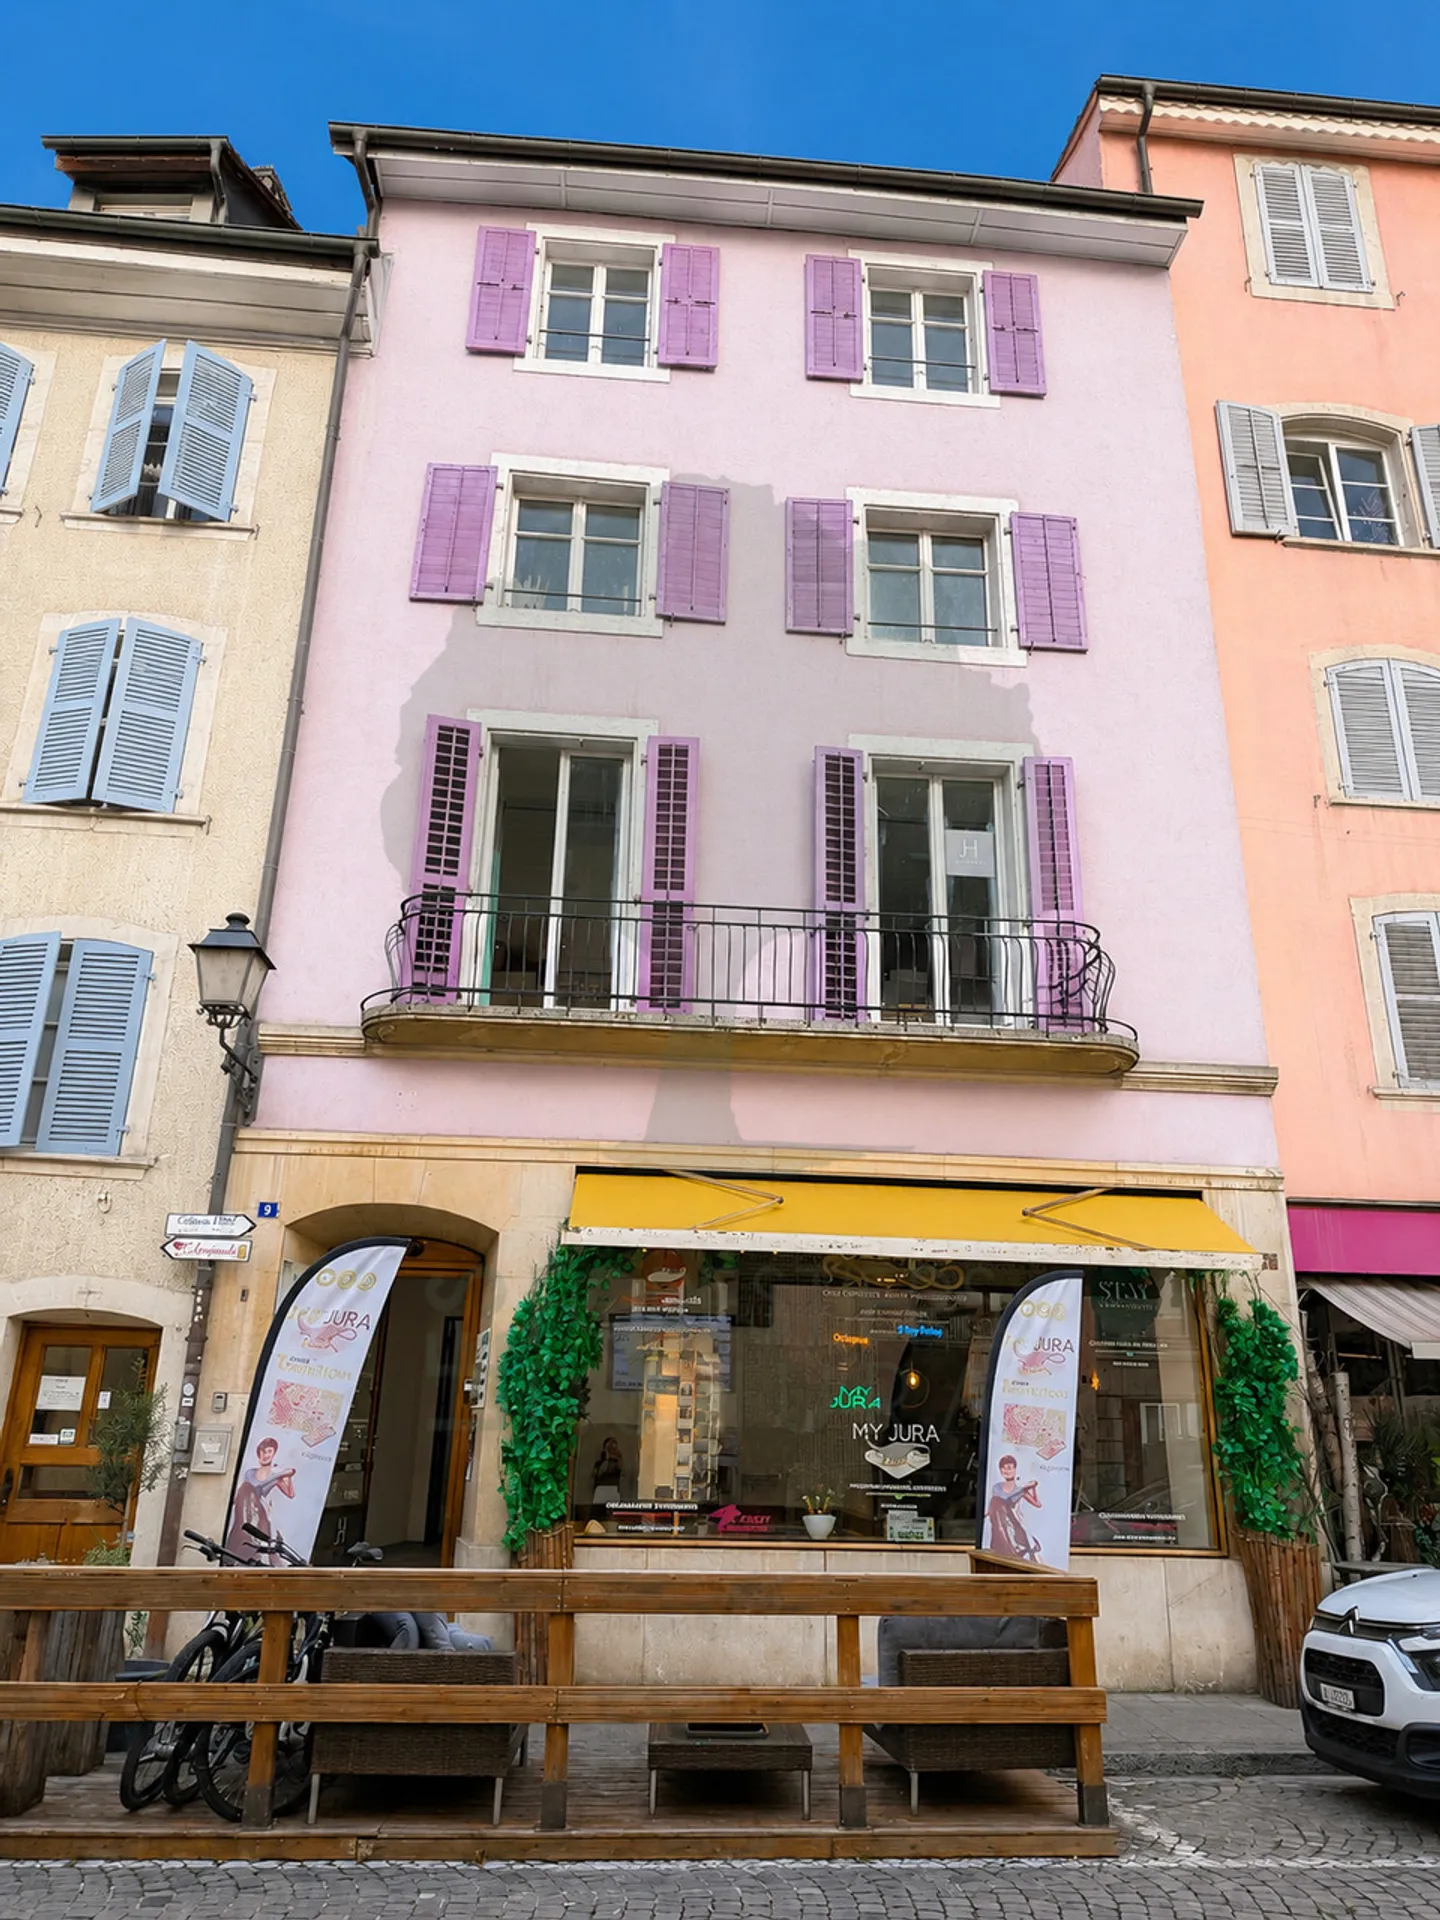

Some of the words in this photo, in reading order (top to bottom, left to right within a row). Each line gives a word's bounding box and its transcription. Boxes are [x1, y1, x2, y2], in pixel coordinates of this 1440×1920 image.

[263, 1204, 272, 1216] 9
[322, 1309, 371, 1331] JURA
[1033, 1336, 1075, 1353] JURA
[851, 1422, 884, 1441] MY
[887, 1423, 941, 1443] JURA
